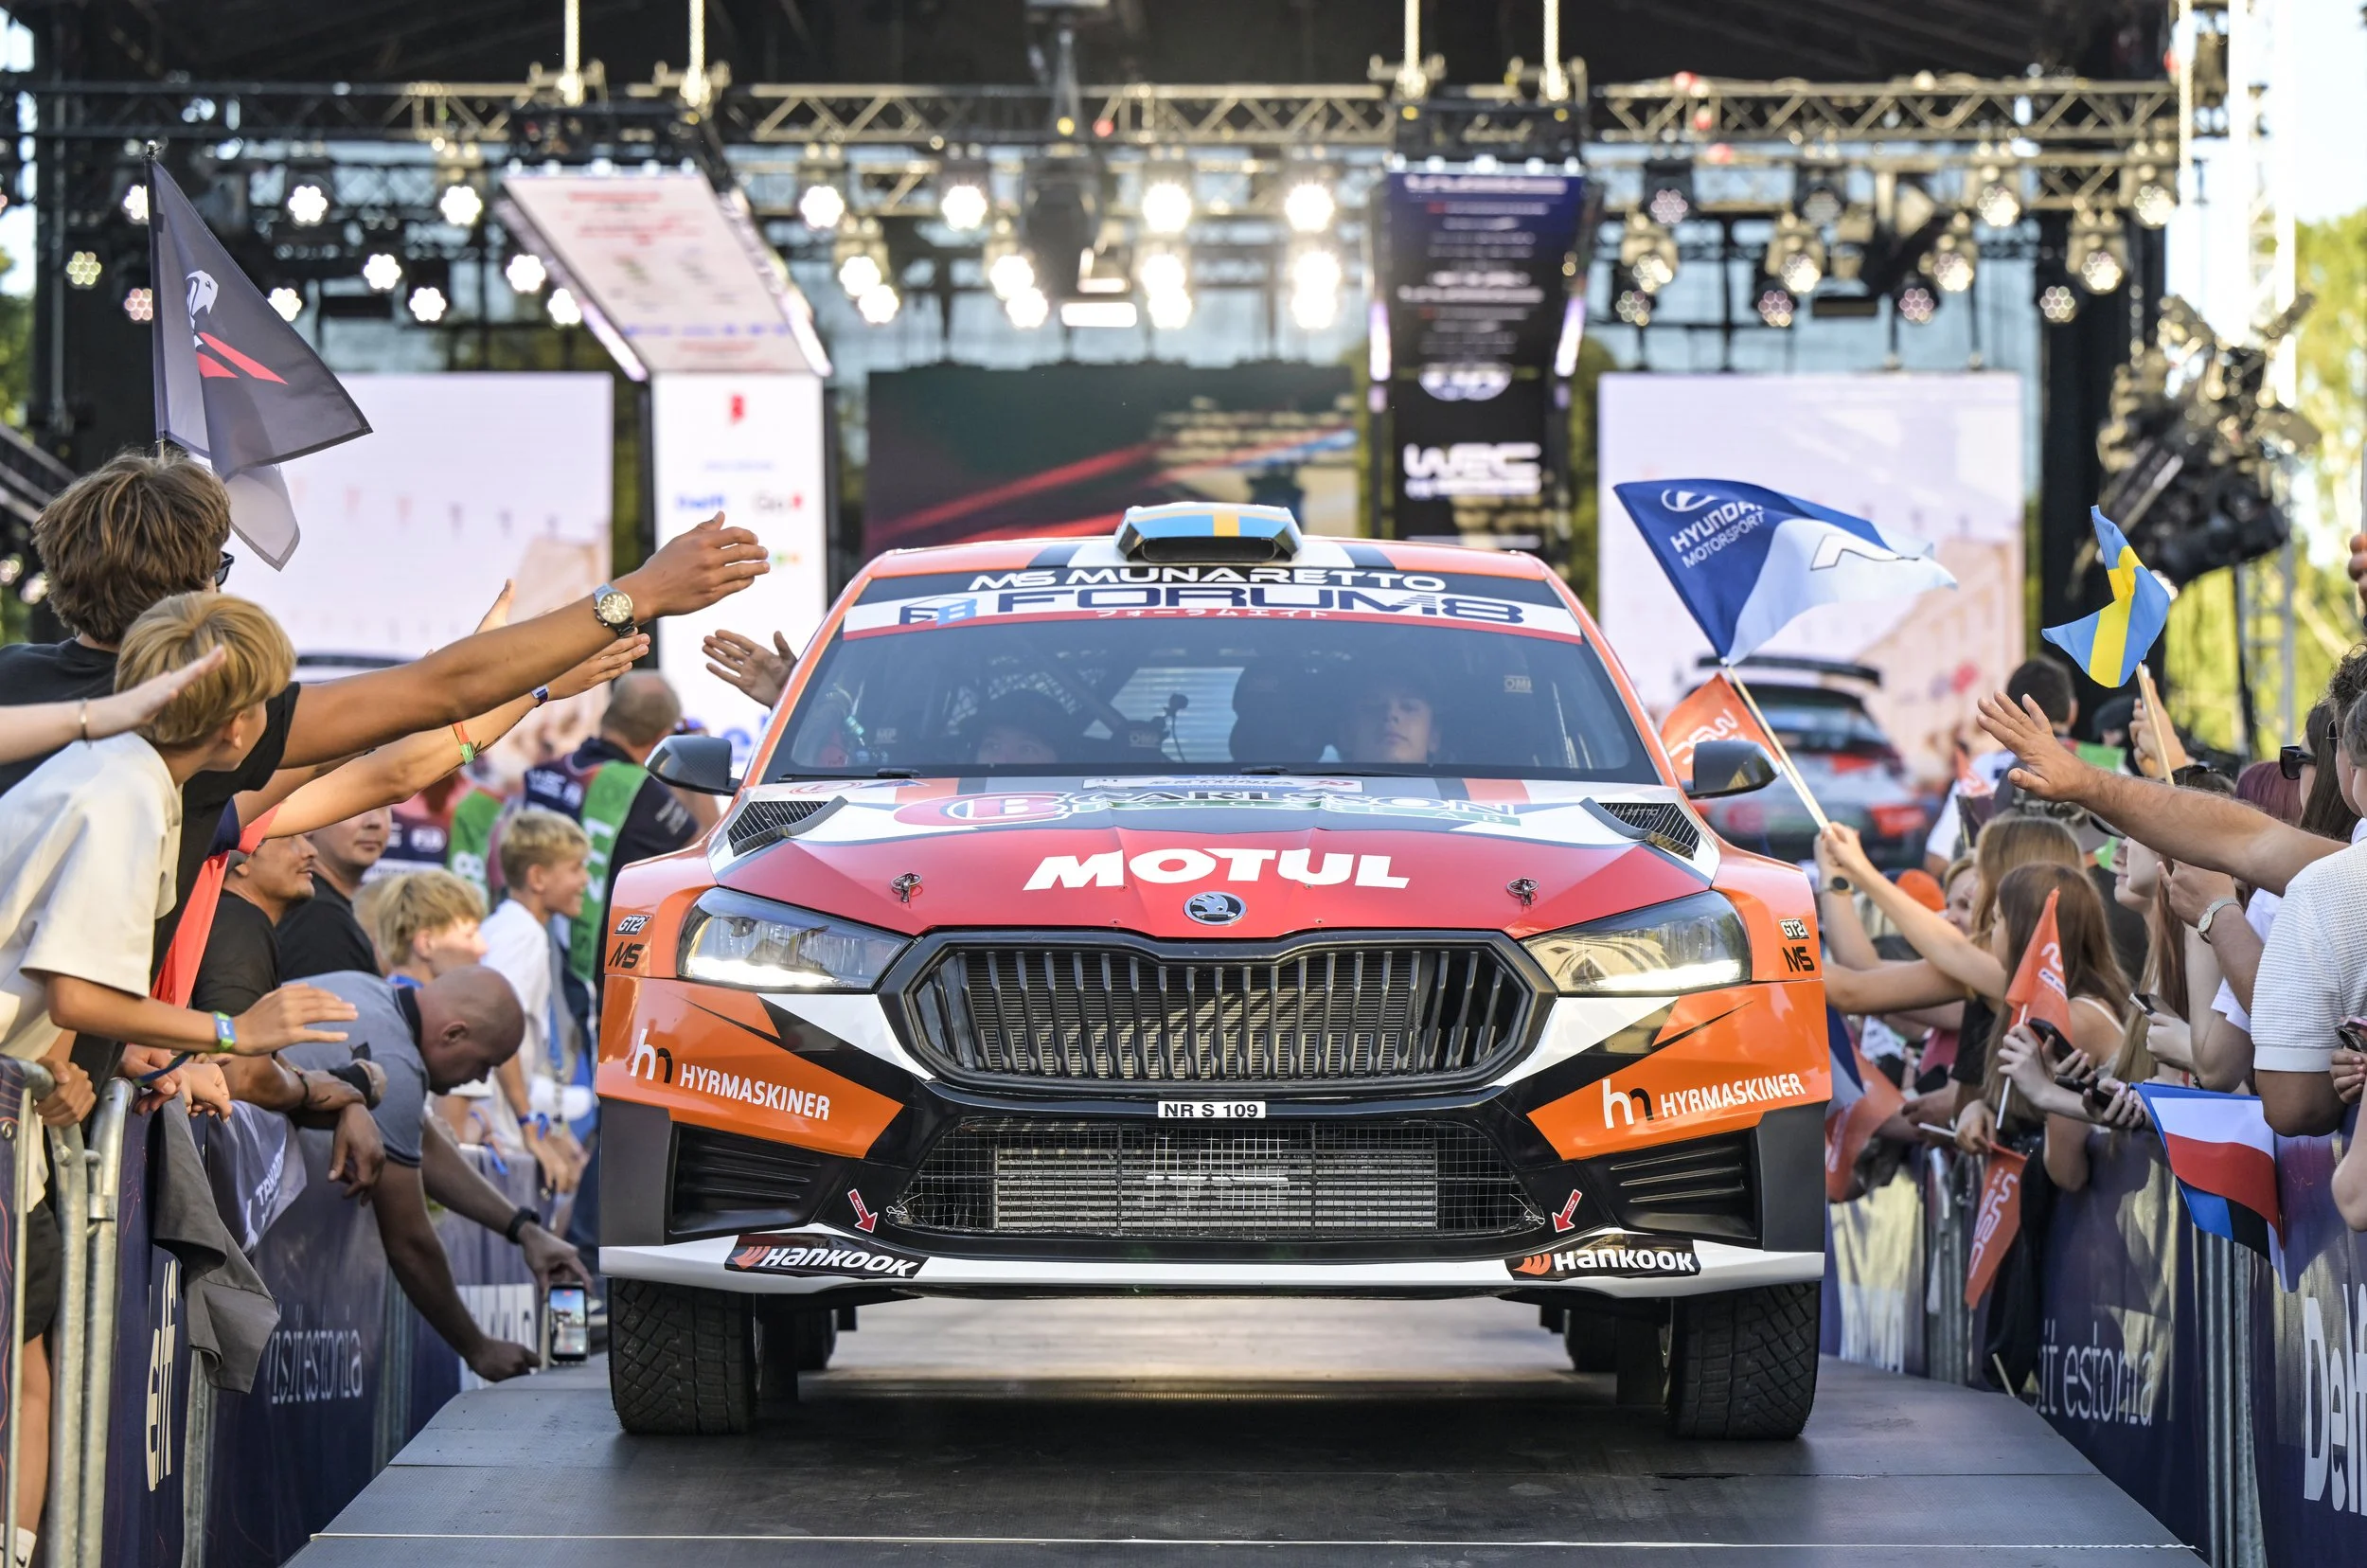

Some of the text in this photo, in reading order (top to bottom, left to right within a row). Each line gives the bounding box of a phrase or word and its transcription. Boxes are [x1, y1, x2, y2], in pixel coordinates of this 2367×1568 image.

[1668, 500, 1764, 554] HYUNDA
[1681, 511, 1765, 569] MOTORSPORT
[968, 567, 1446, 592] MS MUNARETTO
[997, 585, 1524, 624] FORUM8
[1095, 608, 1328, 618] フォーラムエイト
[1070, 790, 1517, 817] CARLSSON
[1023, 847, 1411, 891] MOTUL
[608, 941, 645, 969] MS
[1782, 946, 1815, 972] MS
[679, 1062, 831, 1121] HYRMASKINER
[1660, 1072, 1806, 1119] HYRMASKINER
[1164, 1103, 1258, 1117] NR S 109
[854, 1199, 863, 1212] TOW
[1567, 1199, 1576, 1212] TOW
[2063, 1320, 2155, 1427] estonia
